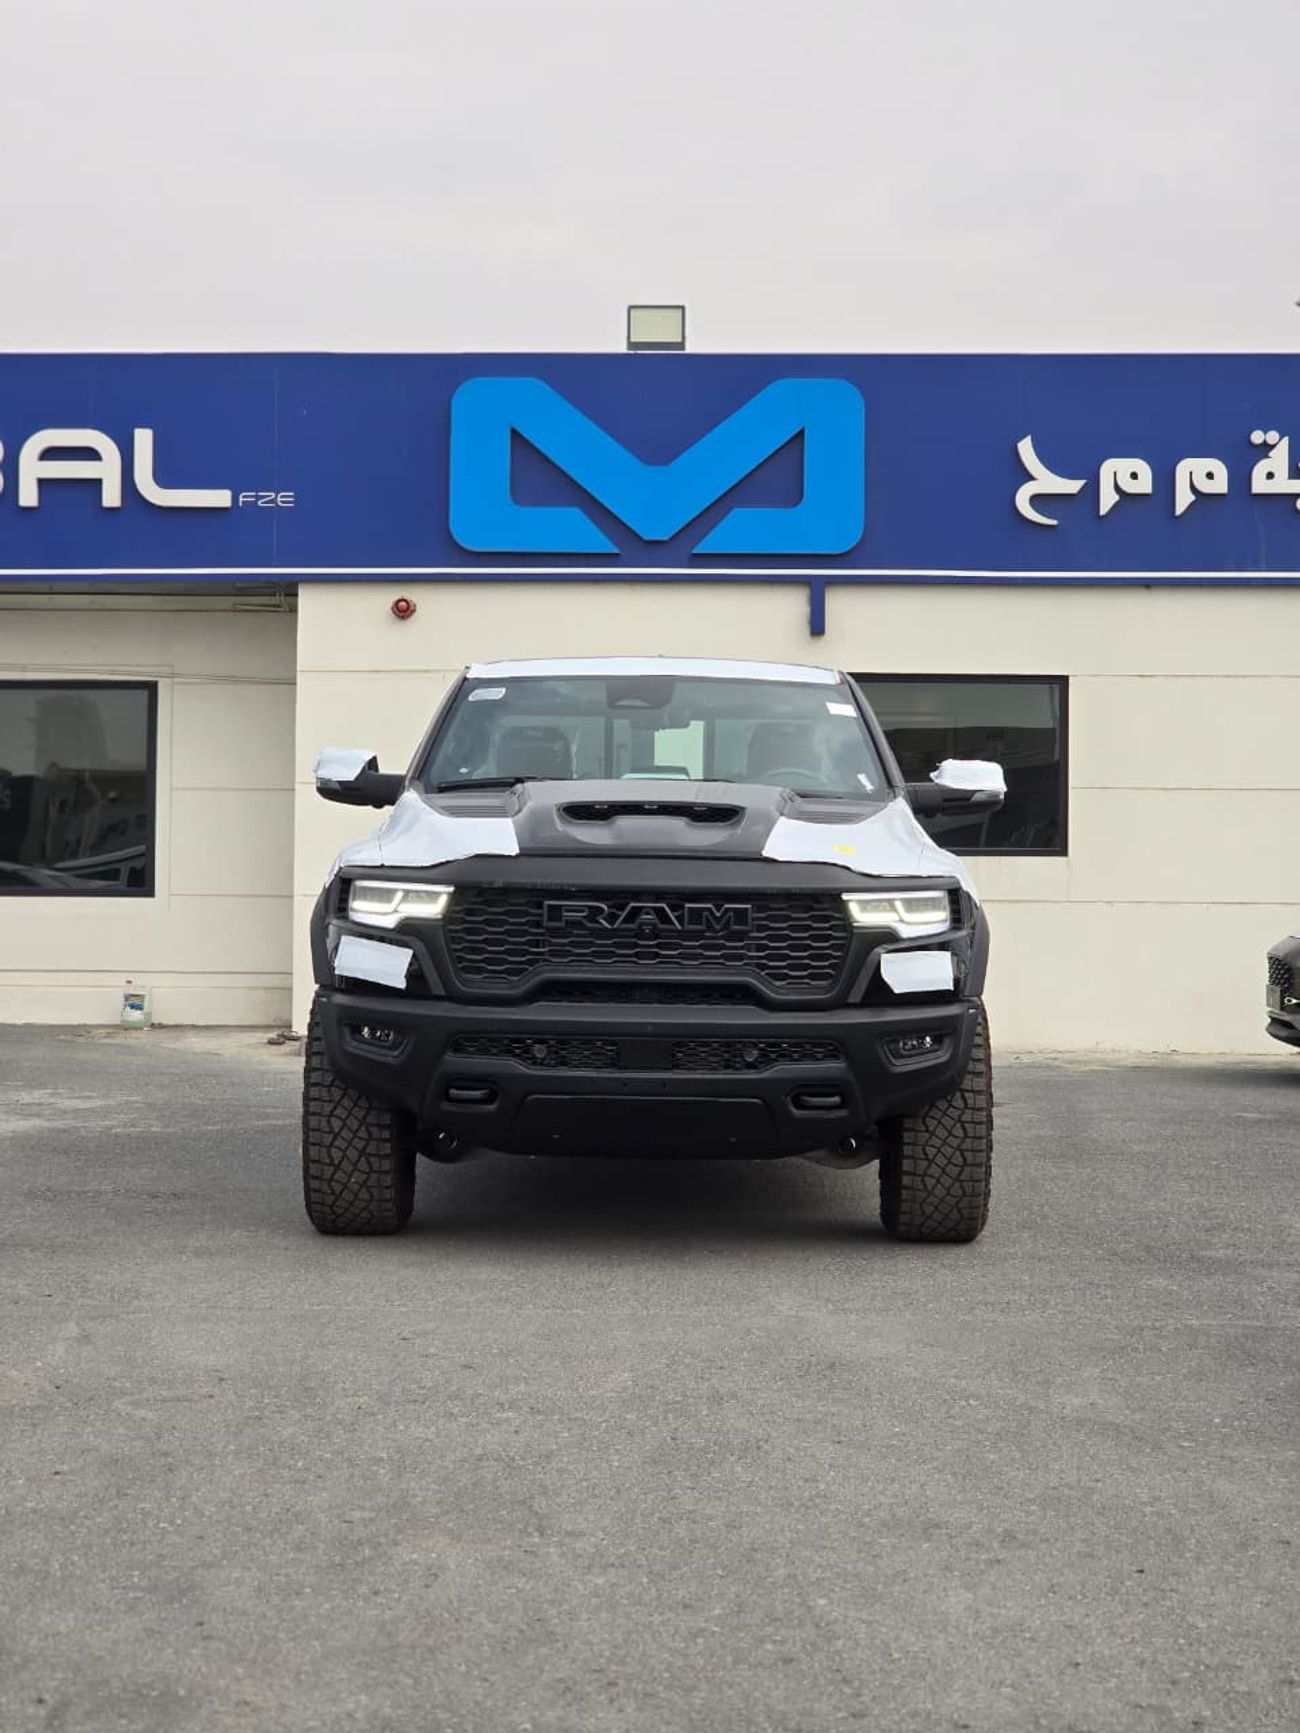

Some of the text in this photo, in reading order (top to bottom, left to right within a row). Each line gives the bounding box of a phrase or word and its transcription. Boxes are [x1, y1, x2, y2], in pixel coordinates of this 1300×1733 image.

[0, 428, 295, 508] AL FZE
[543, 900, 753, 930] RAM
